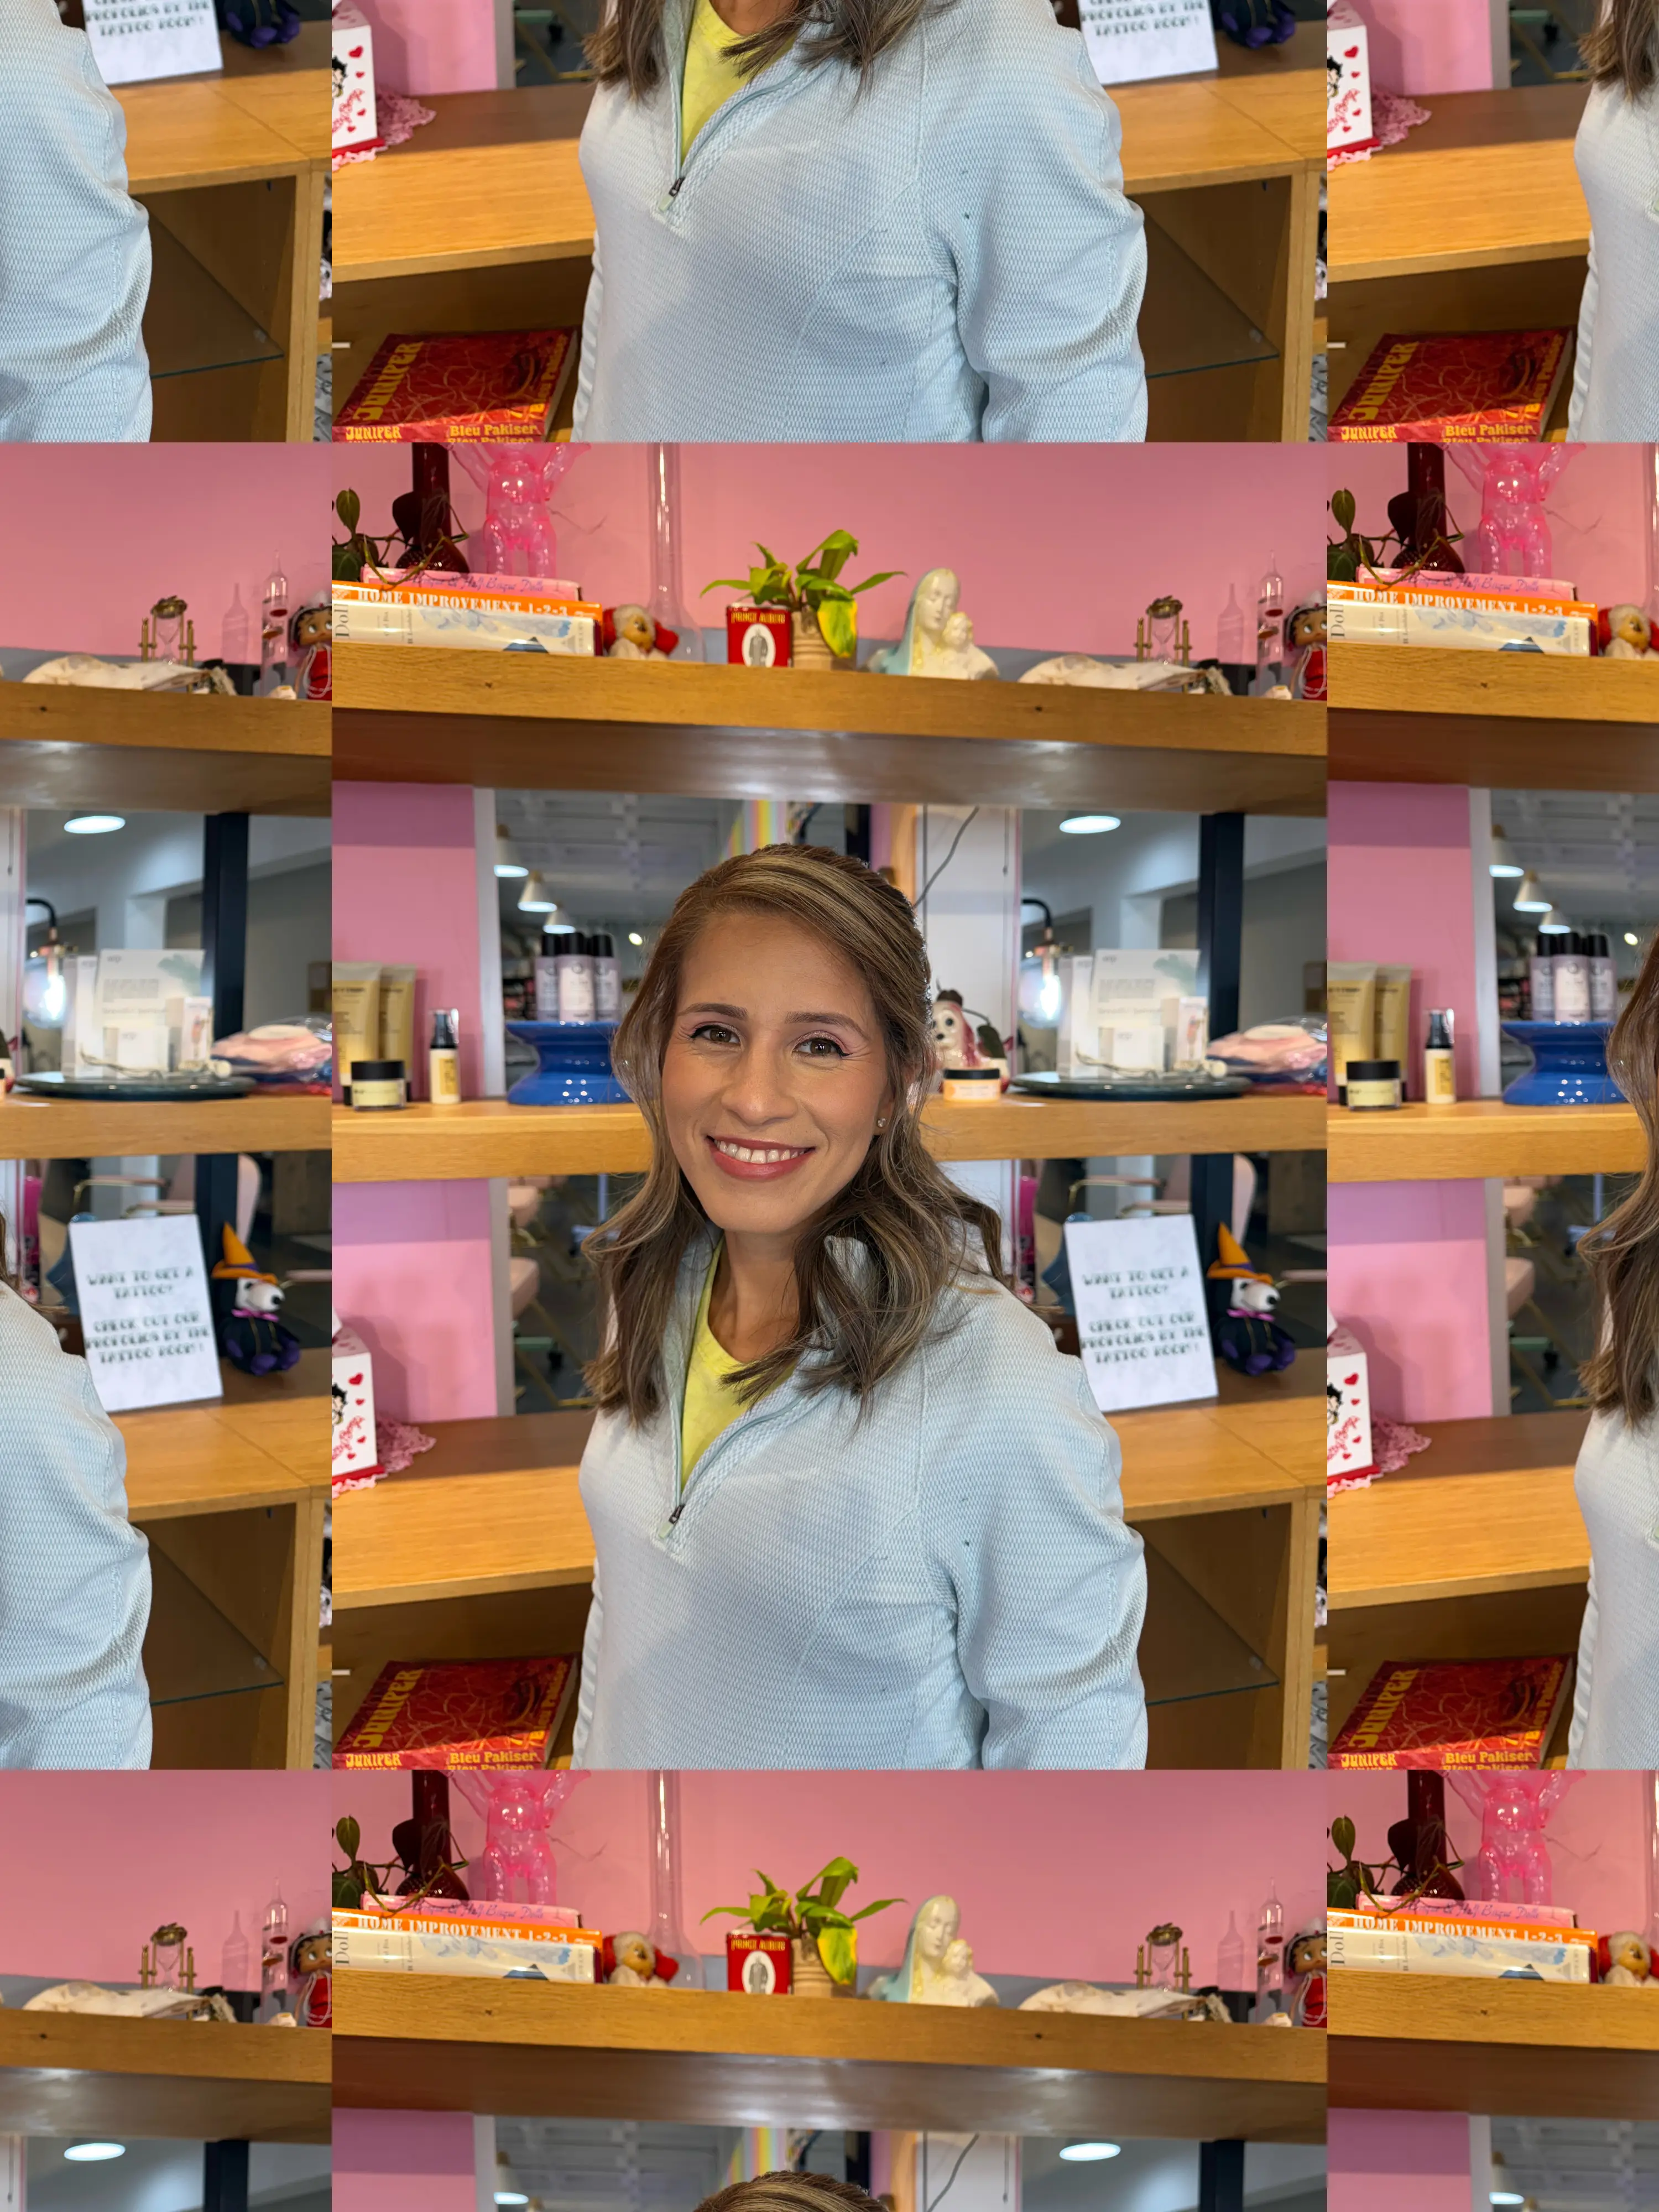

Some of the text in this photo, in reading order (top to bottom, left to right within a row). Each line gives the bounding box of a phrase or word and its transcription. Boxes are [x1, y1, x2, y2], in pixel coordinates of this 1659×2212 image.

[353, 341, 425, 420] JUNIPER
[1348, 341, 1420, 420] JUNIPER
[346, 424, 536, 440] JUNIPER Bleu Pakiser
[1341, 424, 1532, 440] JUNIPER Bleu Pakiser
[358, 590, 403, 604] HOME
[409, 592, 521, 614] IMPROVEMENT
[1353, 590, 1398, 604] HOME
[1405, 592, 1517, 614] IMPROVEMENT
[353, 1668, 425, 1747] JUNIPER
[1348, 1668, 1420, 1747] JUNIPER
[346, 1751, 536, 1767] JUNIPER Bleu Pakiser
[1341, 1751, 1532, 1767] JUNIPER Bleu Pakiser
[358, 1917, 403, 1931] HOME
[409, 1919, 521, 1941] IMPROVEMENT
[1353, 1917, 1398, 1931] HOME
[1405, 1919, 1517, 1941] IMPROVEMENT
